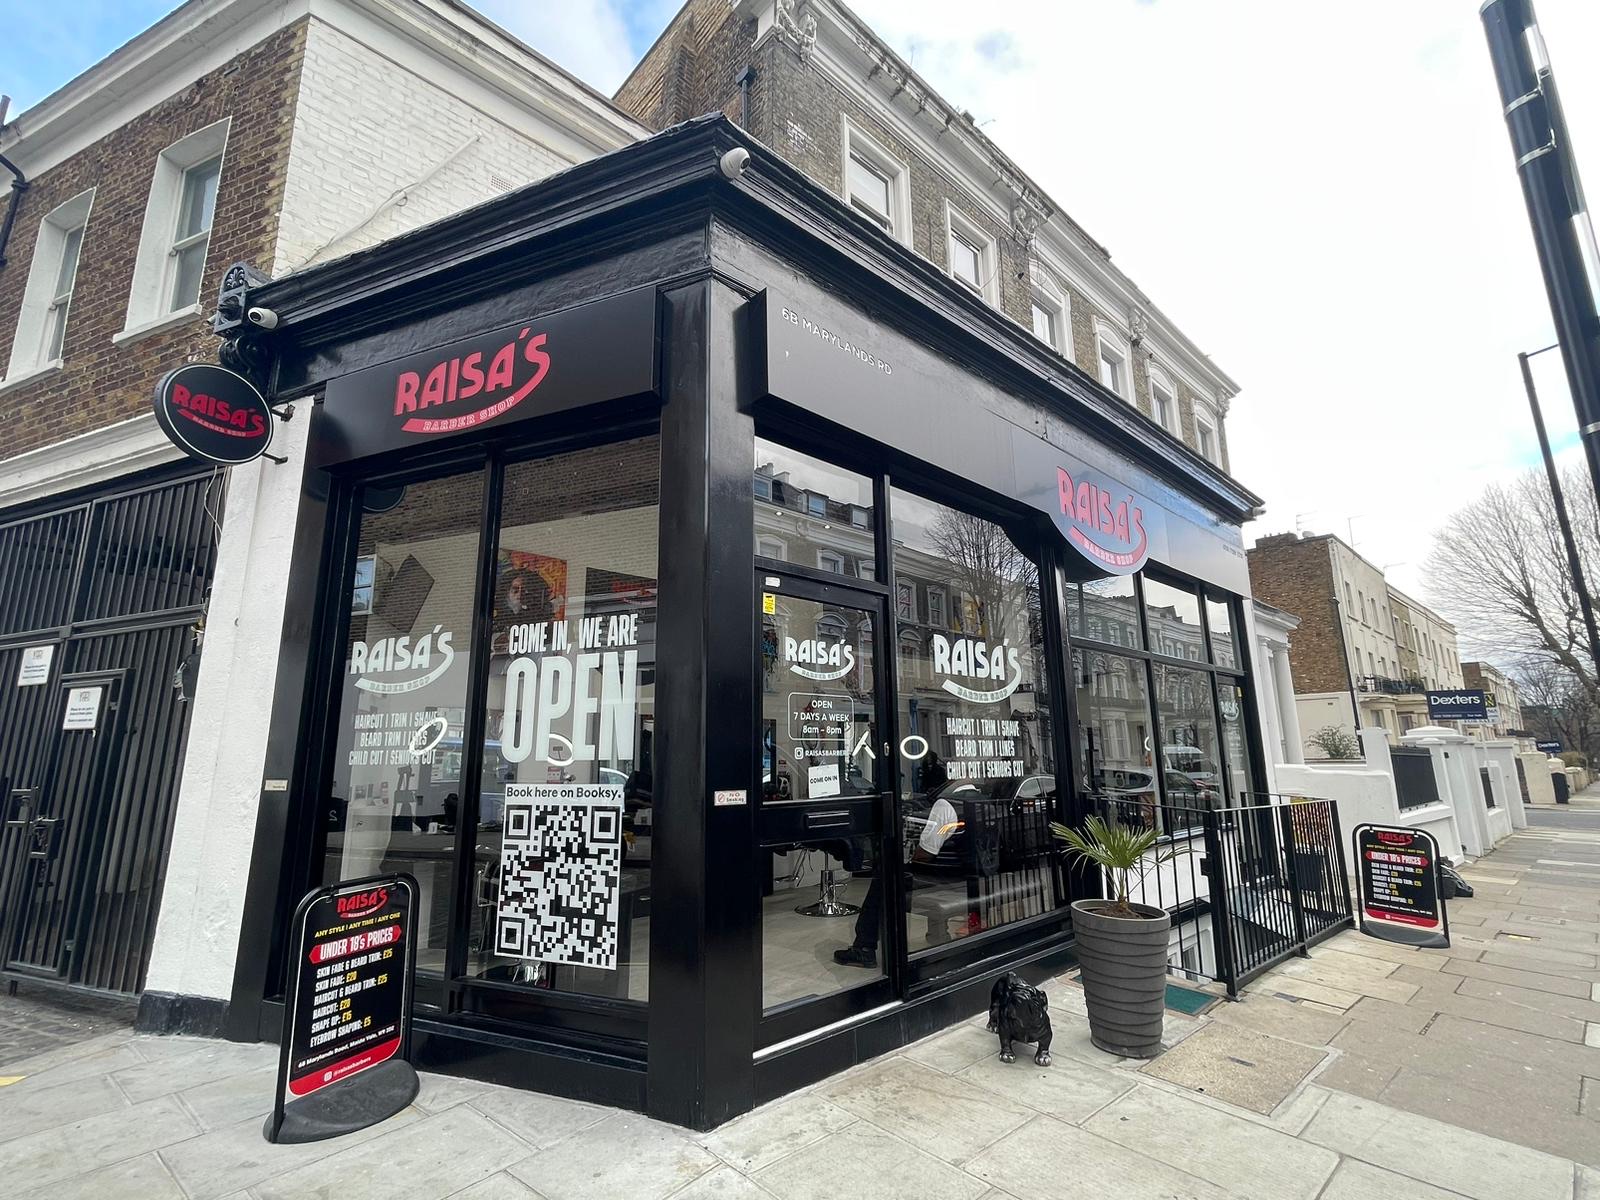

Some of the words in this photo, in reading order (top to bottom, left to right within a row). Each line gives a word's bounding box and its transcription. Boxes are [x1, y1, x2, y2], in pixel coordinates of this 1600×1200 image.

[782, 307, 798, 325] 6B
[802, 318, 875, 366] MARYLANDS
[877, 359, 892, 375] RD
[423, 415, 475, 432] BARBER
[480, 396, 515, 420] SHOP
[509, 622, 549, 655] COME
[552, 620, 571, 653] IN,
[579, 617, 602, 649] WE
[607, 614, 638, 646] ARE
[502, 650, 638, 763] OPEN
[812, 700, 832, 709] OPEN
[1430, 694, 1480, 705] Dexters
[354, 713, 384, 729] HAIRCUT
[391, 712, 408, 727] TRIM
[793, 712, 798, 720] 7
[800, 712, 820, 721] DAYS
[822, 713, 827, 721] A
[829, 713, 849, 721] WEEK
[946, 717, 974, 735] HAIRCUT
[981, 719, 997, 736] TRIM
[1001, 720, 1020, 736] SHAVE
[360, 731, 382, 747] BEARD
[385, 731, 401, 746] TRIM
[802, 726, 819, 734] 8am
[826, 726, 841, 735] 8pm
[349, 750, 368, 766] CHILD
[370, 750, 383, 765] CUT
[421, 749, 437, 765] CUT
[955, 740, 977, 757] BEARD
[978, 740, 993, 757] TRIM
[999, 740, 1015, 757] LINES
[946, 761, 967, 780] CHILD
[968, 761, 981, 779] CUT
[987, 760, 1012, 778] SENIORS
[1013, 760, 1024, 777] CUT
[507, 787, 532, 797] Book
[534, 787, 558, 798] here
[561, 789, 573, 798] on
[576, 787, 621, 800] Booksy.
[314, 930, 328, 938] ANY
[328, 925, 345, 935] STYLE
[348, 921, 362, 930] ANY
[361, 918, 374, 926] TIME
[377, 915, 389, 923] ANY
[389, 912, 400, 920] ONE
[320, 937, 348, 960] UNDER
[349, 934, 366, 952] 18's
[367, 926, 394, 948] PRICES
[317, 966, 331, 979] SKIN
[331, 962, 345, 974] FADE
[350, 955, 367, 968] BEARD
[383, 948, 393, 959] £25
[314, 989, 338, 1006] HAIRCUT
[345, 981, 362, 996] BEARD
[377, 973, 388, 985] £25
[315, 979, 330, 992] SKIN
[346, 970, 357, 983] £20
[339, 997, 351, 1011] £20
[310, 1028, 337, 1048] EYEBROW
[363, 1015, 372, 1028] £5
[311, 1018, 330, 1034] SHAPE
[342, 1010, 352, 1023] £15
